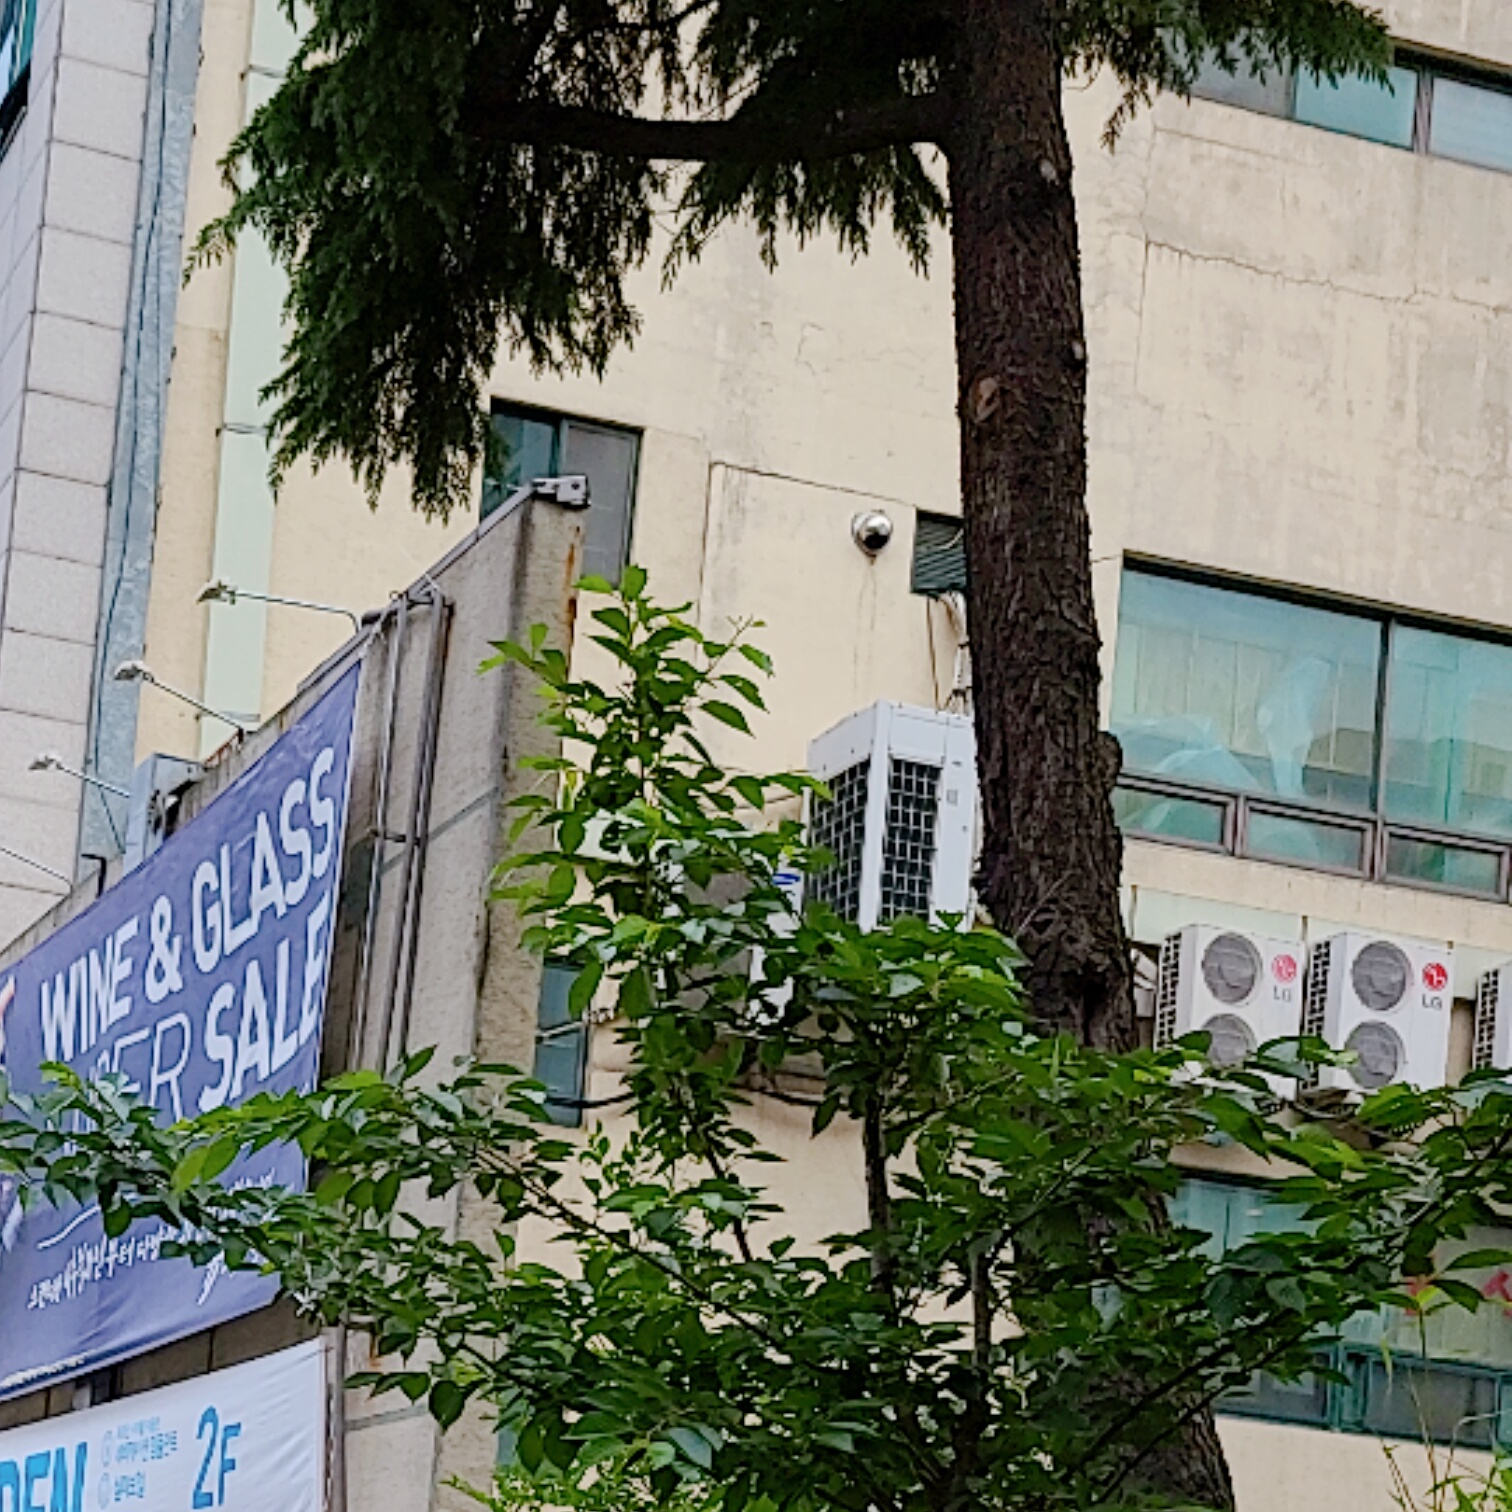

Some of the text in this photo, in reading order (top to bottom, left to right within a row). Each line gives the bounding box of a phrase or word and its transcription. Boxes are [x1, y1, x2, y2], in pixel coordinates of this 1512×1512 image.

[40, 746, 336, 1064] WINE & GLASS
[199, 891, 330, 1114] SALE
[1273, 985, 1292, 1002] LG
[1421, 994, 1444, 1010] LG
[192, 1405, 241, 1510] 2F
